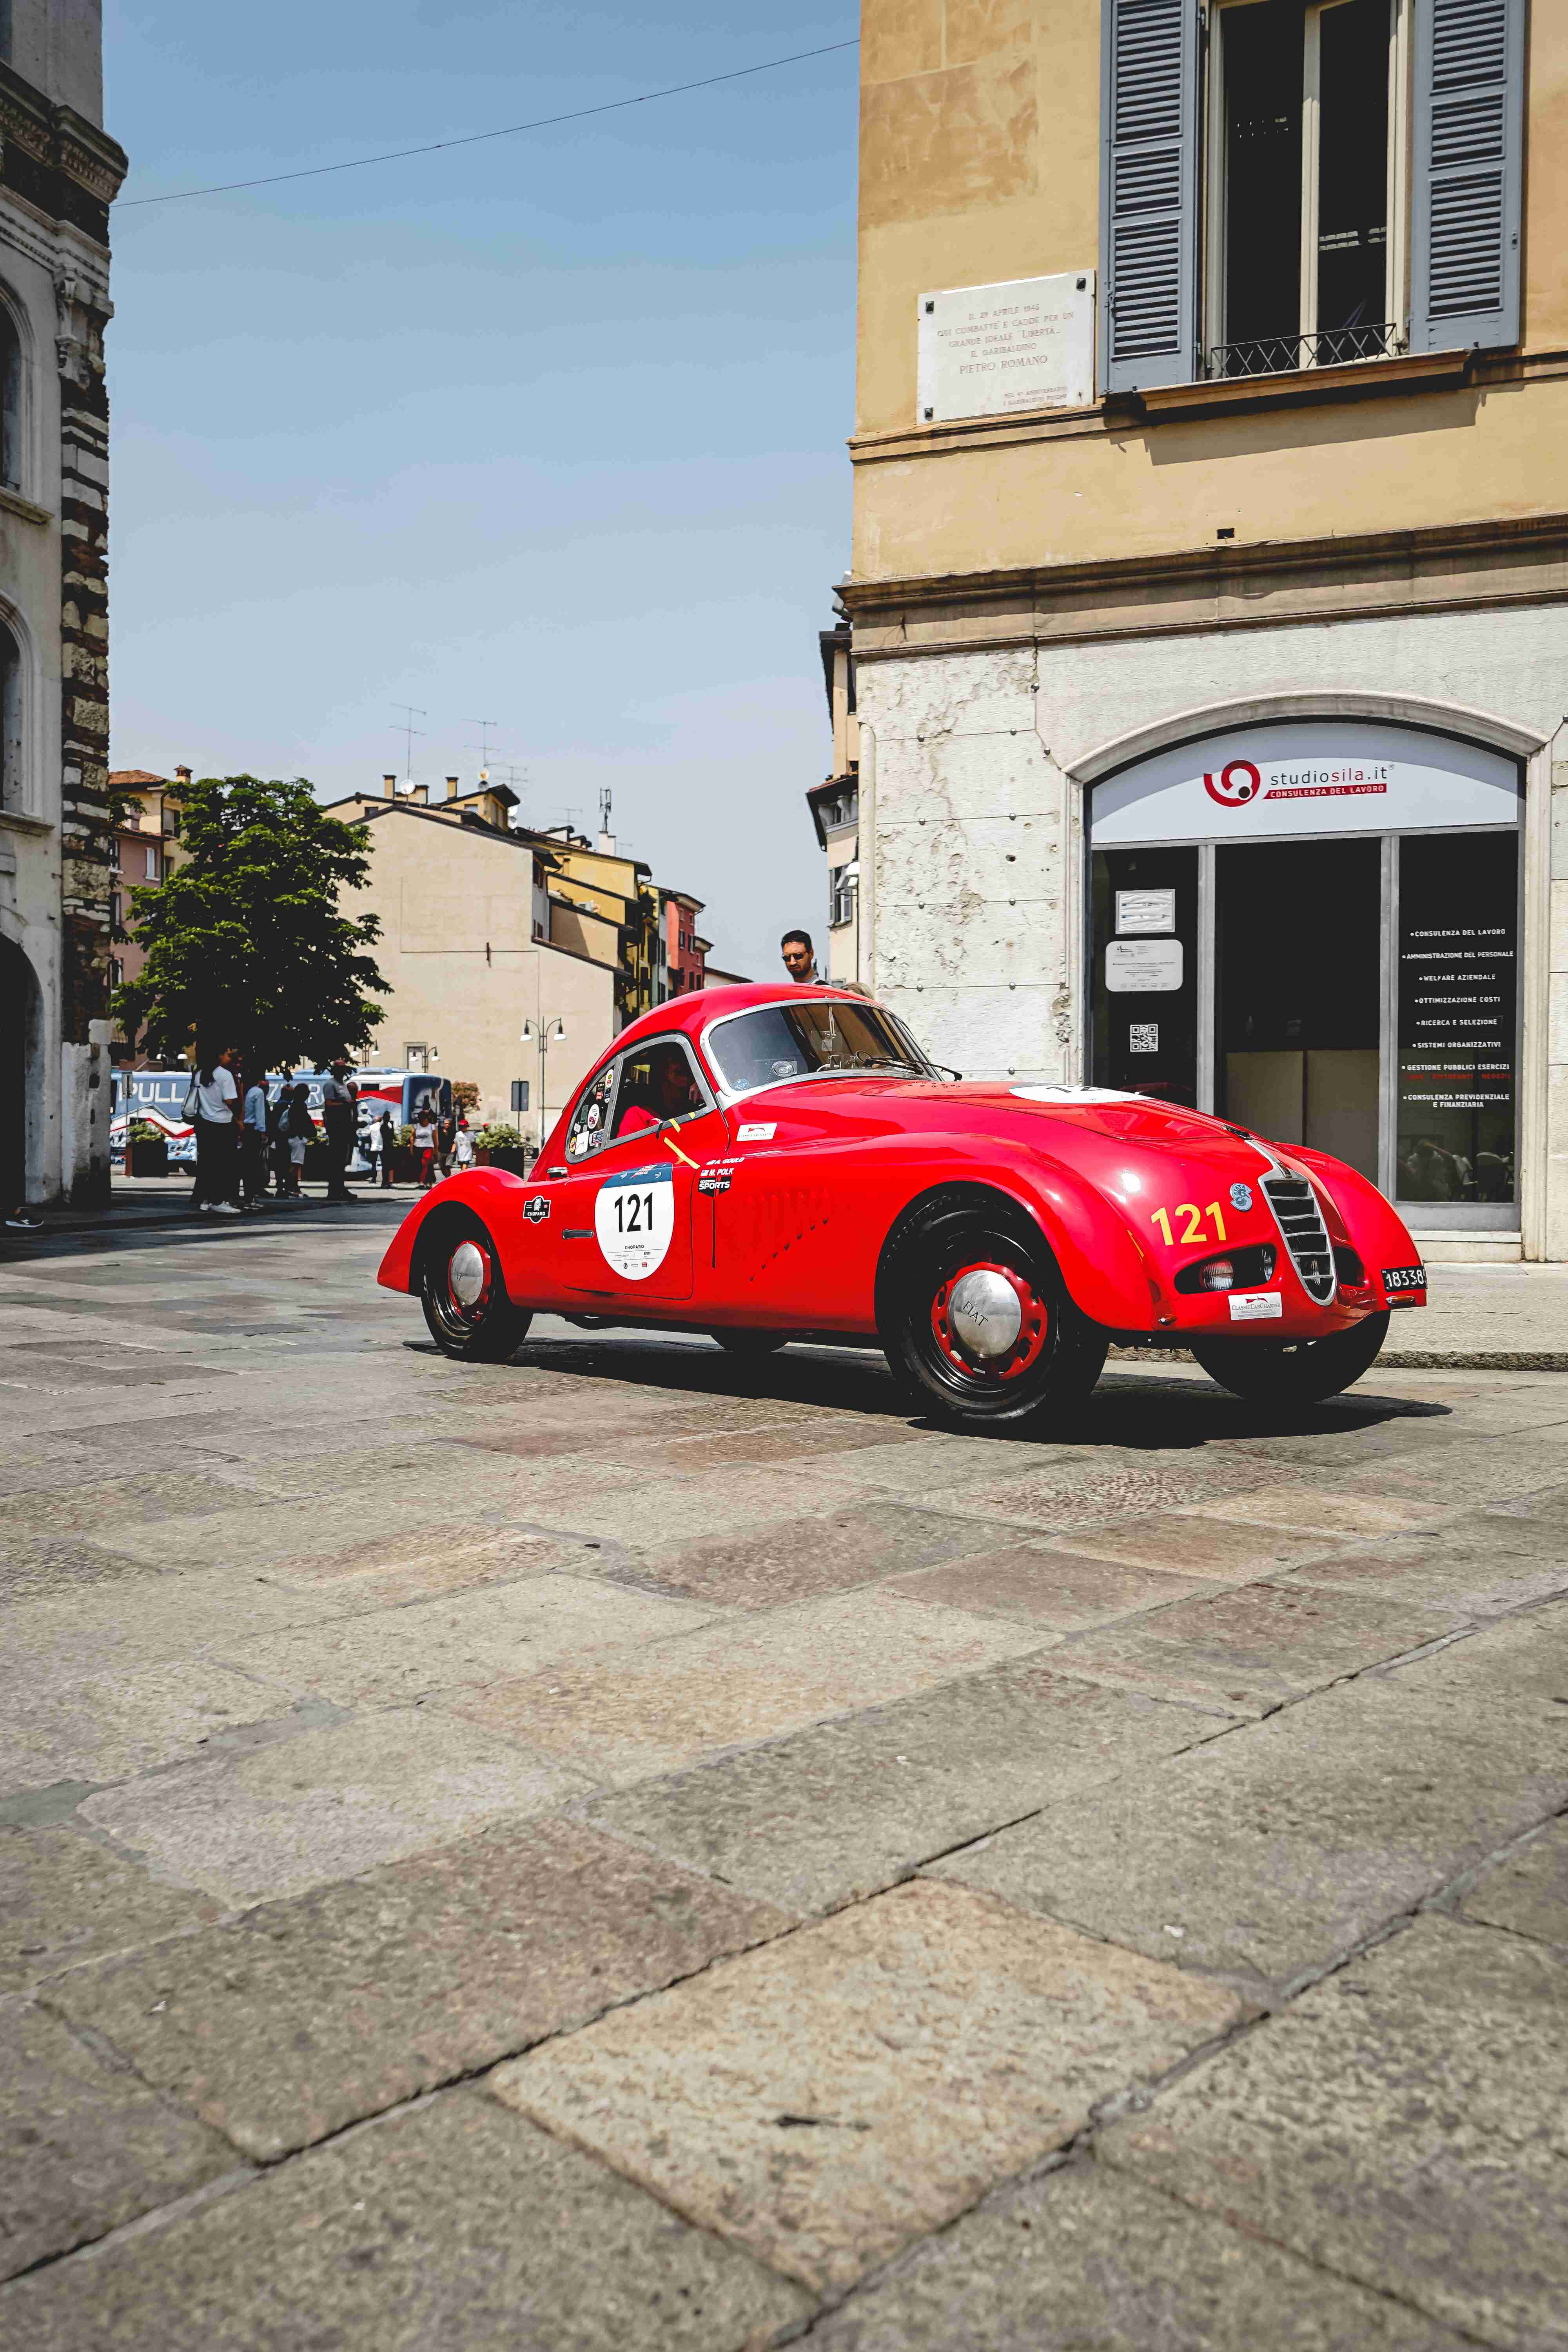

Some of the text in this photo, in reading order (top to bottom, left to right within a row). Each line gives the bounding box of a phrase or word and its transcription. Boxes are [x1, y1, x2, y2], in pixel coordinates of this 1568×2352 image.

[992, 307, 1019, 317] APRILE
[1012, 317, 1040, 326] CADDE
[1063, 312, 1074, 320] UN
[949, 338, 981, 348] GRANDE
[985, 333, 1013, 343] IDEALE
[982, 342, 1037, 356] GARIBALDINO
[959, 355, 1048, 375] PIETRO ROMANO
[1270, 766, 1388, 786] studiosila.it
[1270, 788, 1327, 798] CONSULENZA
[1350, 785, 1384, 793] LAVORO
[699, 1181, 730, 1190] SPORTS
[614, 1192, 653, 1233] 121
[1151, 1201, 1227, 1246] 121
[1386, 1269, 1426, 1287] 18338
[963, 1301, 988, 1326] FIAT
